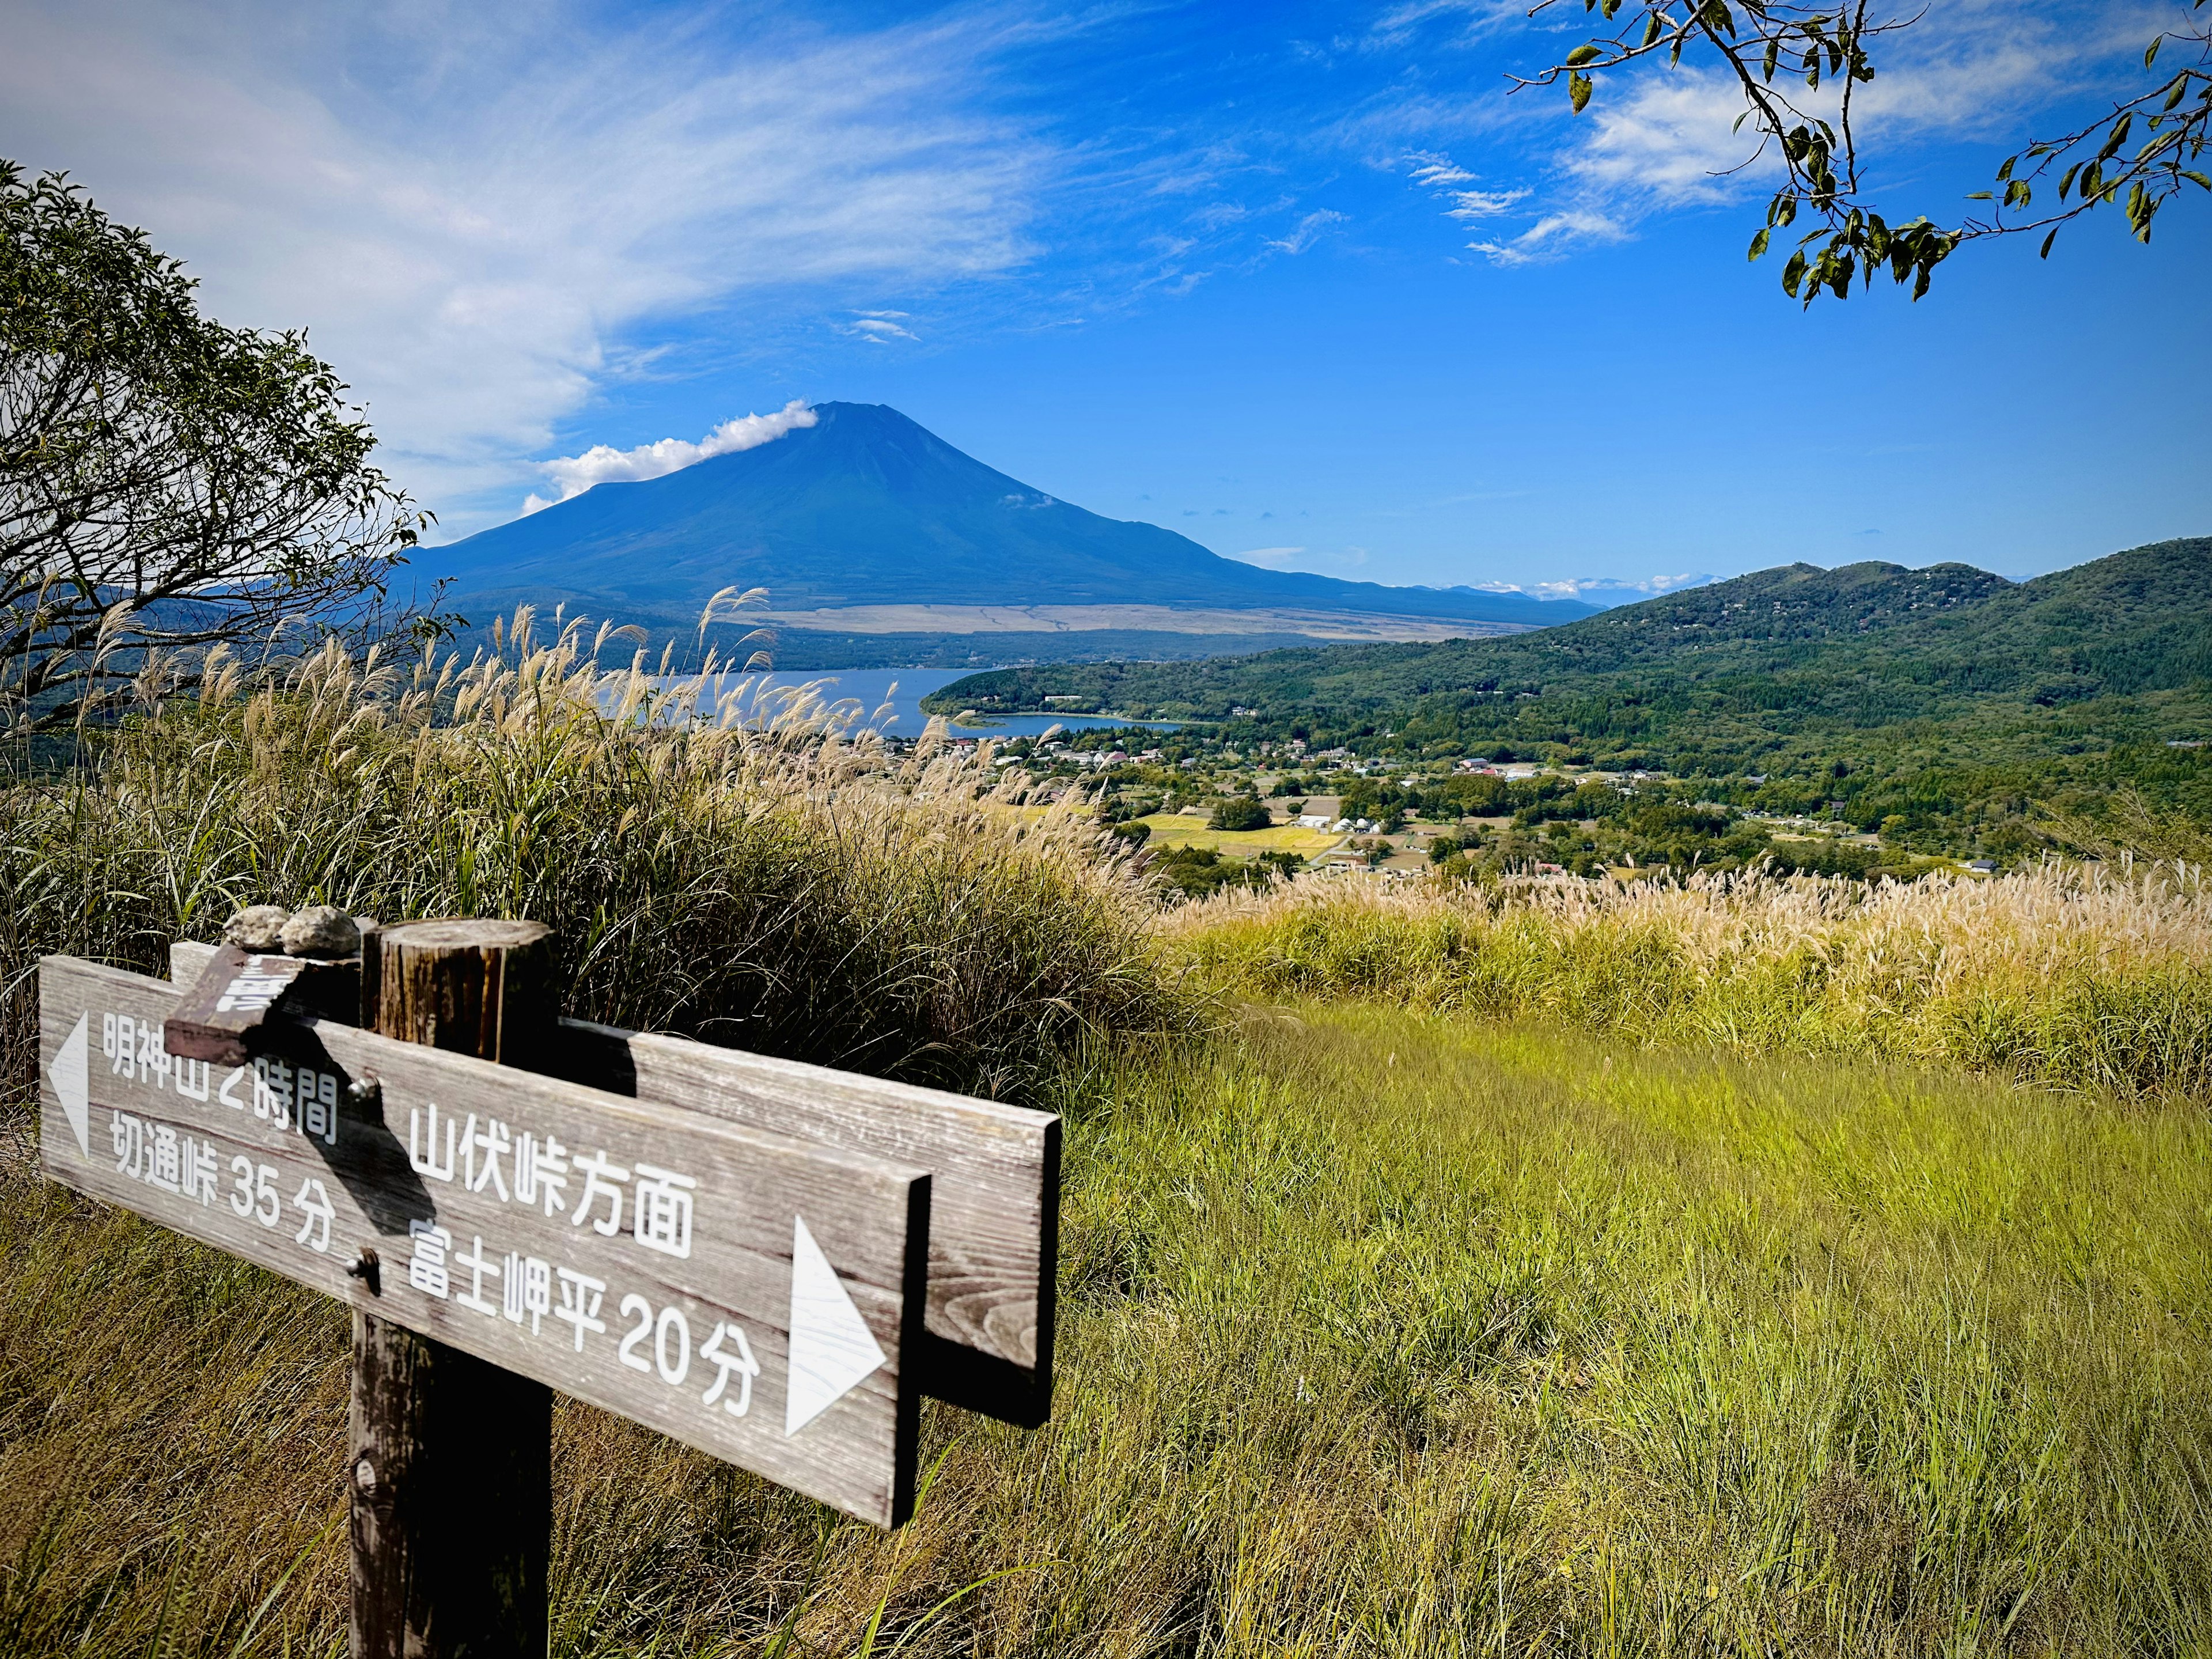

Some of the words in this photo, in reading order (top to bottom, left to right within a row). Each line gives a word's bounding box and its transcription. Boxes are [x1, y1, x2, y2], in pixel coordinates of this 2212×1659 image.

[408, 1102, 697, 1259] 山伏峠方面
